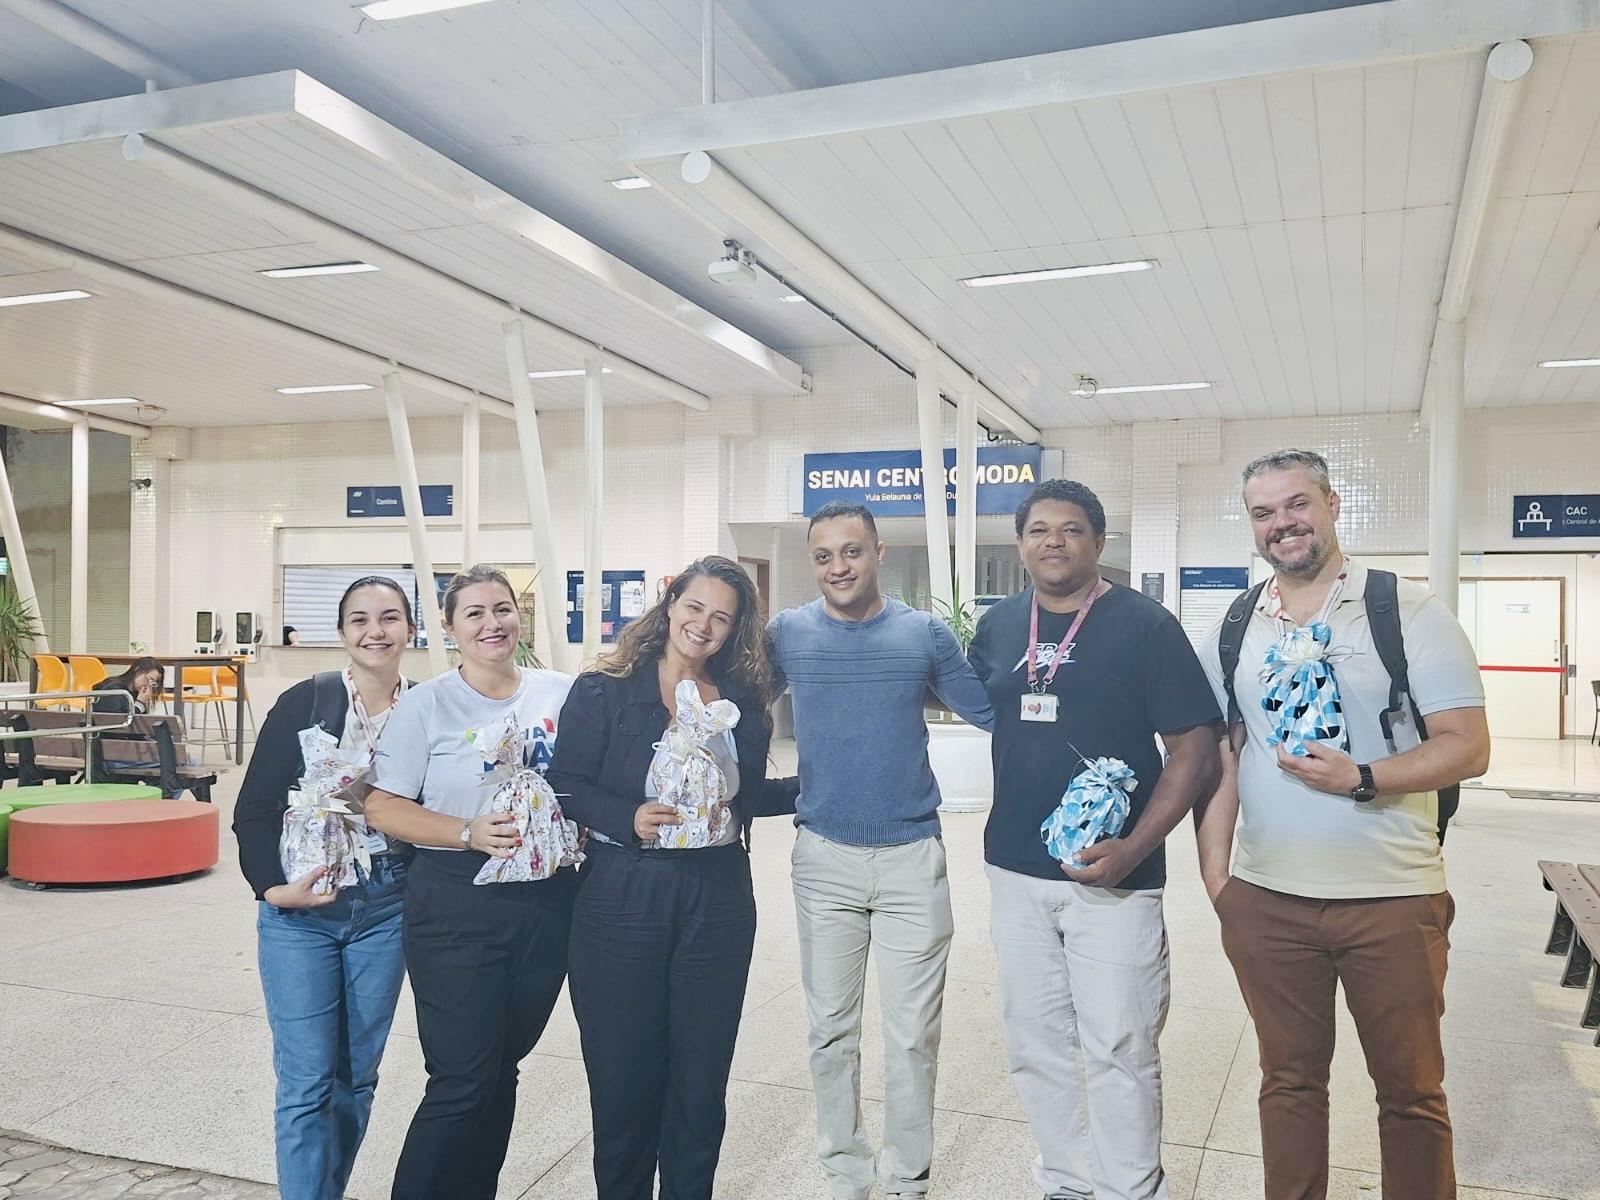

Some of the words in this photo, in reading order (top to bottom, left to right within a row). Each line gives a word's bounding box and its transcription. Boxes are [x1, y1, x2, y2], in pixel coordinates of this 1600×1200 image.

[807, 469, 871, 489] SENAI
[876, 465, 958, 487] CENO
[912, 492, 923, 500] de
[1566, 506, 1588, 516] CAC
